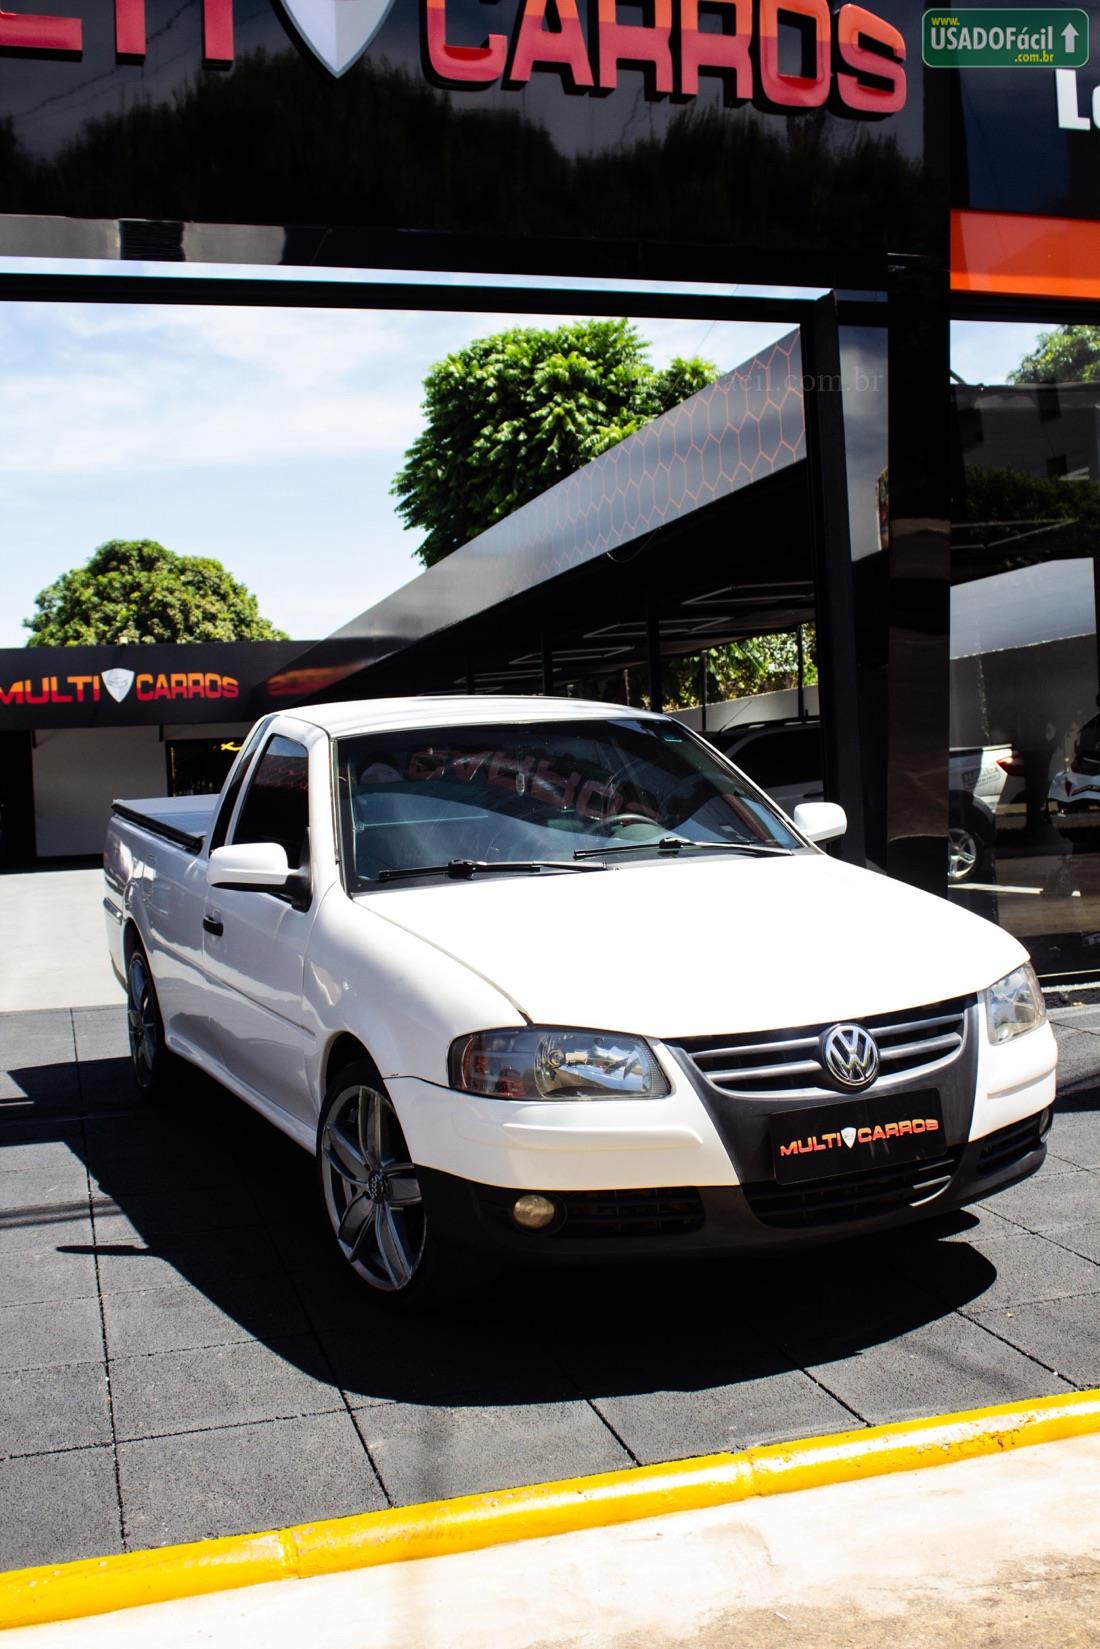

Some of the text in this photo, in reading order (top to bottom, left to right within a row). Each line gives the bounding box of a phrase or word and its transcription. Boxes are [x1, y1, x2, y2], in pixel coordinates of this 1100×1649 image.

[424, 0, 908, 115] CARROS
[1055, 68, 1100, 131] L
[0, 673, 240, 705] MULTI CARROS
[779, 1119, 939, 1157] MULTI CARROS
